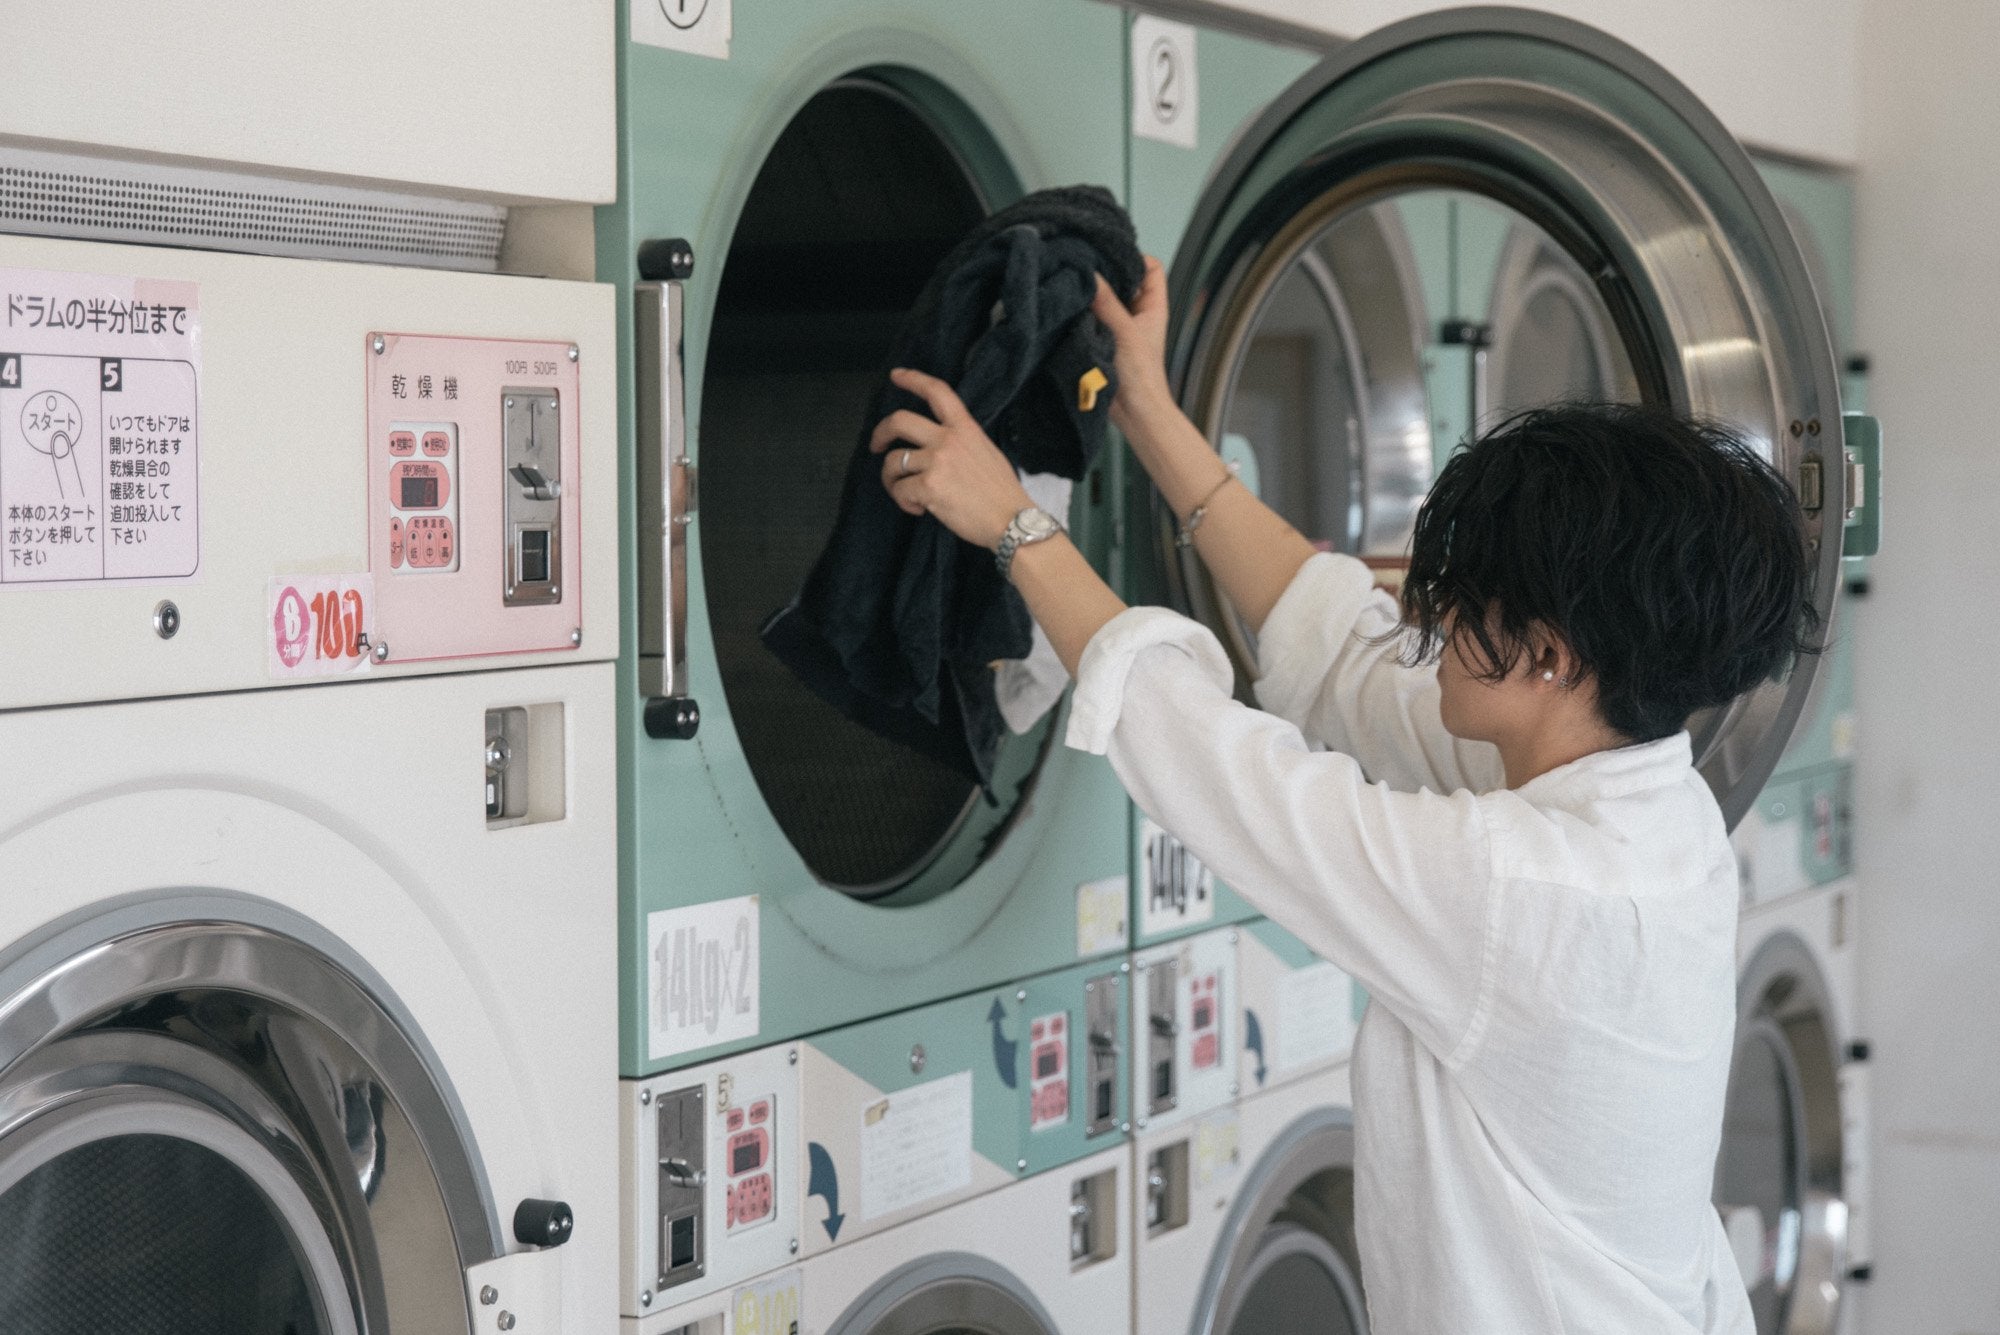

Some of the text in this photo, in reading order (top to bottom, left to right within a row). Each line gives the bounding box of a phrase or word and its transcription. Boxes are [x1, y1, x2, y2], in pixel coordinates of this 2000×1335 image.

[8, 293, 187, 335] ドラムの半分位まで
[2, 357, 18, 385] 4
[104, 362, 119, 388] 5
[505, 360, 557, 376] 100円 500円
[391, 374, 458, 400] 乾燥機
[28, 412, 76, 431] スタート
[109, 414, 191, 433] いつでもドアは
[109, 436, 182, 455] 開けられます
[109, 459, 170, 478] 乾燥具合の
[110, 481, 170, 501] 確認をして
[8, 503, 96, 523] 本体のスタート
[110, 504, 182, 523] 追加投入して
[8, 526, 96, 546] ボタンを押して
[111, 526, 148, 546] 下さい
[8, 549, 47, 568] 下さい
